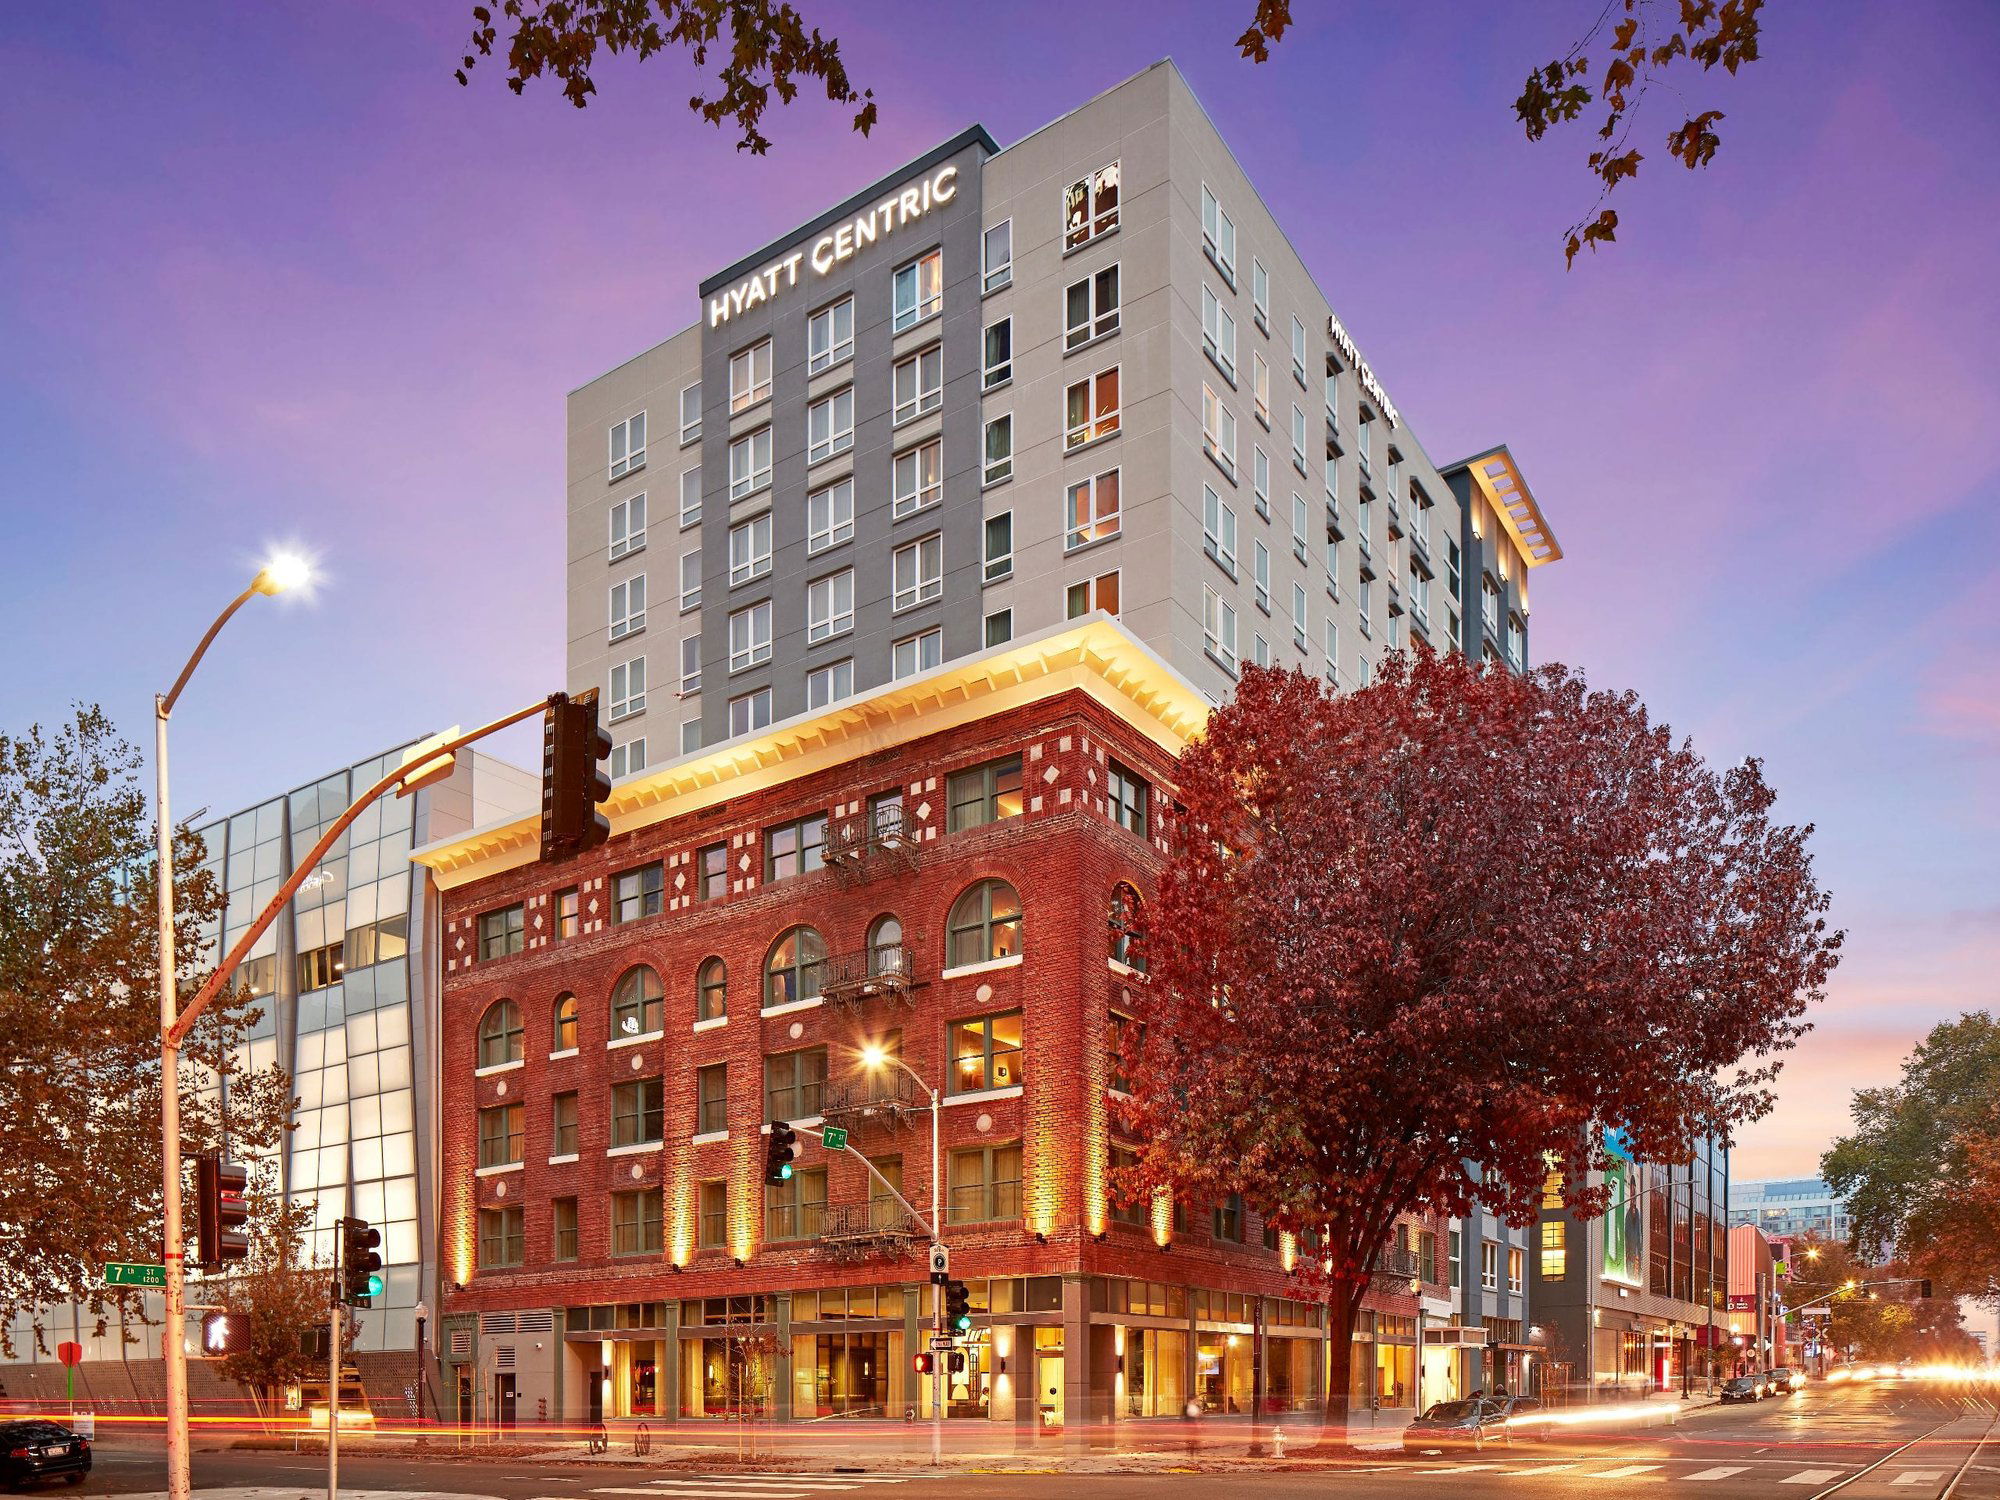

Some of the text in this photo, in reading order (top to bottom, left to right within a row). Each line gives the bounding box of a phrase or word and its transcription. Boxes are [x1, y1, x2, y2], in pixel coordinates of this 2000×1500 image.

[710, 166, 957, 328] HYATT CENTRIC
[146, 1268, 155, 1276] ST
[143, 1276, 160, 1284] 1200
